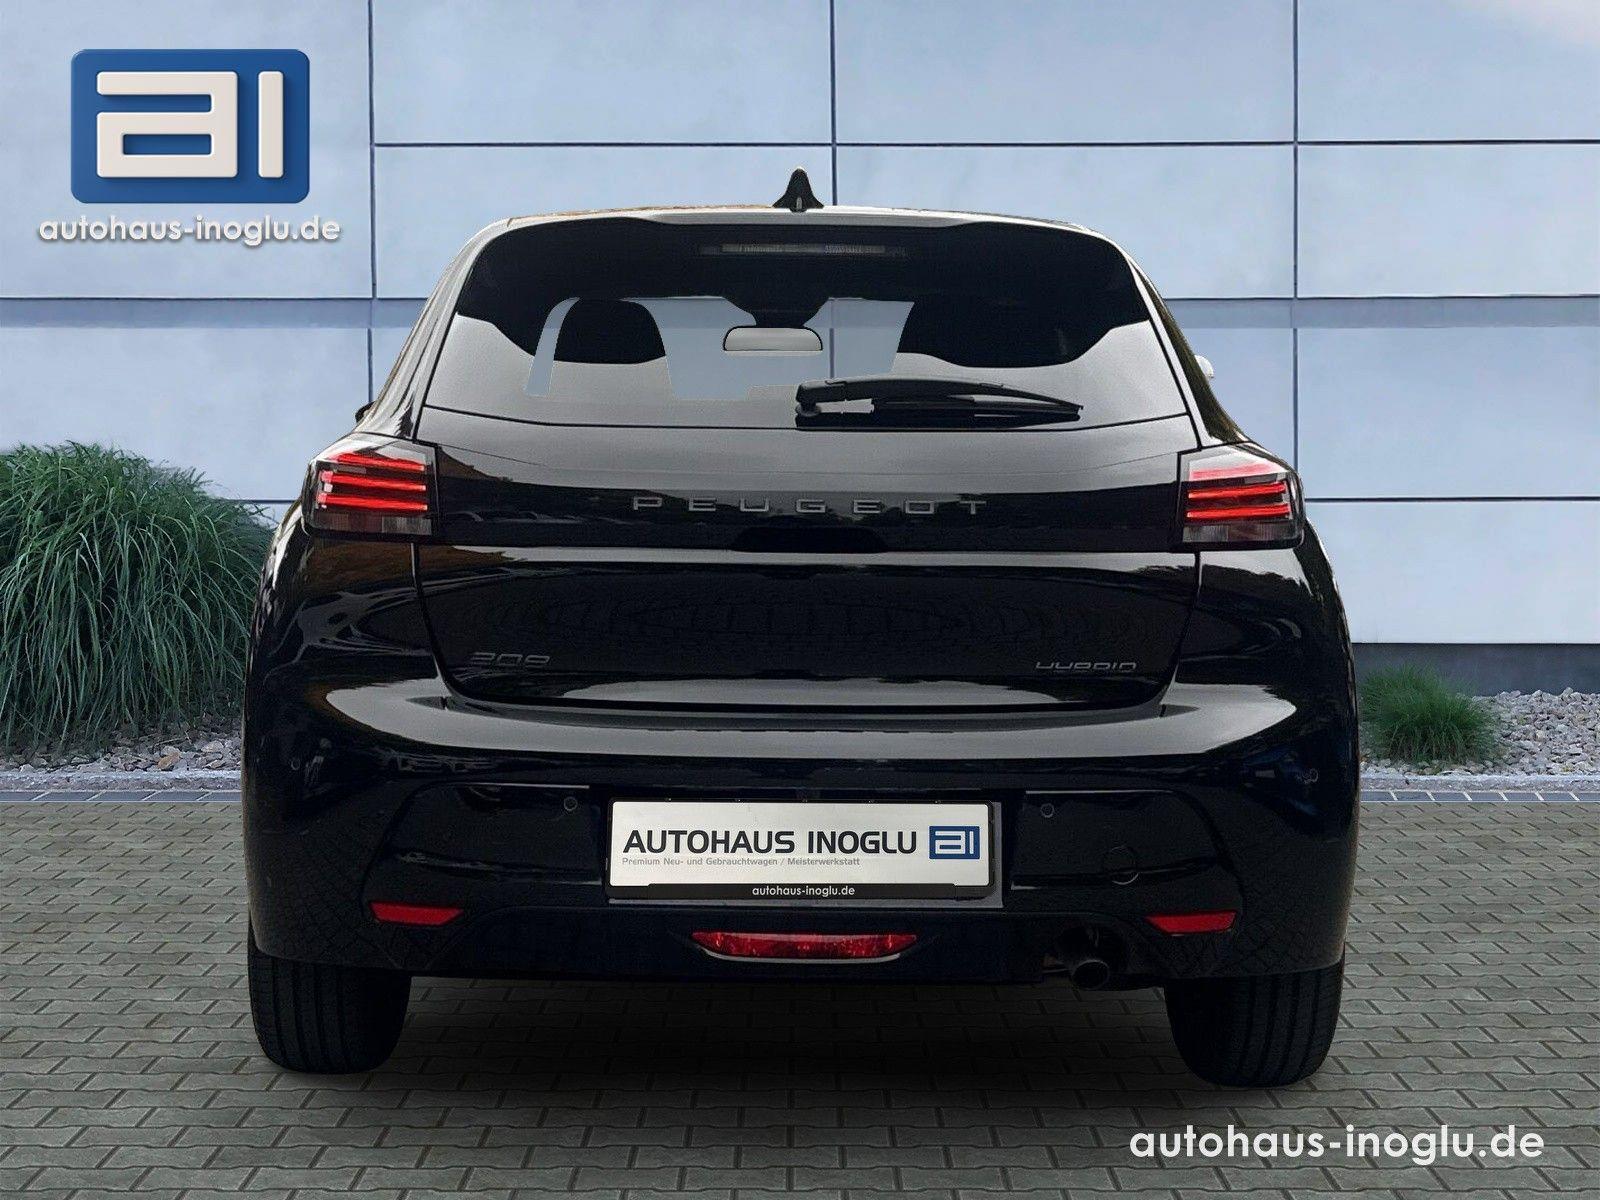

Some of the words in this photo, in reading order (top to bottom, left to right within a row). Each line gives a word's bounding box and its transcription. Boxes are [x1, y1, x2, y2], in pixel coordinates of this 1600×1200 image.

[38, 216, 341, 247] autohaus-inoglu.de
[633, 496, 987, 514] PEUGEOT
[622, 830, 795, 854] AUTOHAUS
[808, 831, 917, 854] INOGLU
[621, 857, 660, 866] Premium
[663, 857, 684, 866] Neu-
[686, 857, 703, 866] und
[705, 857, 778, 868] Gebrauchtwagen
[787, 857, 861, 867] Meisterwerkstatt
[752, 885, 856, 898] autohaus-inoglu.de
